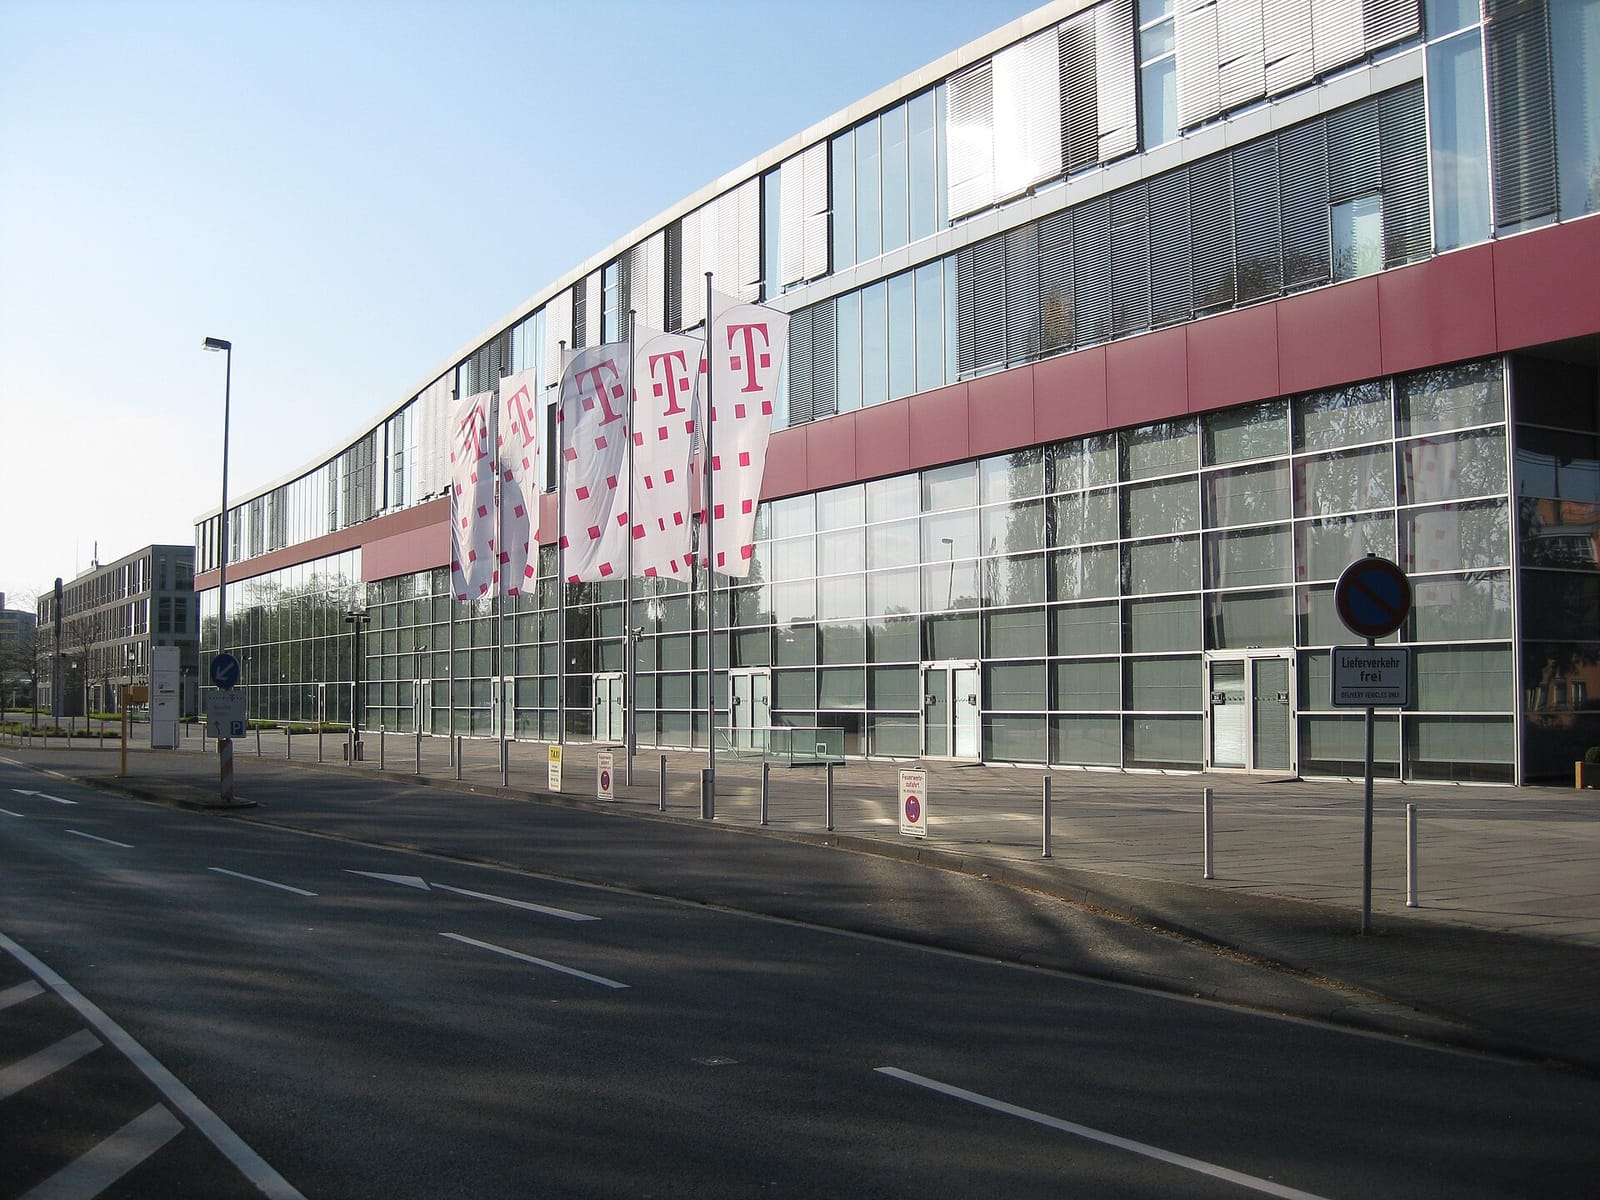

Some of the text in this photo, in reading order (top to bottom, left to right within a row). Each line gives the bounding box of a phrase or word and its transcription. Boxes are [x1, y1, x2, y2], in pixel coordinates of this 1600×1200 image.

[727, 323, 769, 392] T
[575, 359, 623, 426] T
[649, 350, 687, 416] T
[507, 384, 535, 448] T
[1342, 656, 1400, 669] Lieferverkehr
[1360, 670, 1381, 682] frei
[233, 722, 241, 735] P
[550, 750, 560, 759] TAXI
